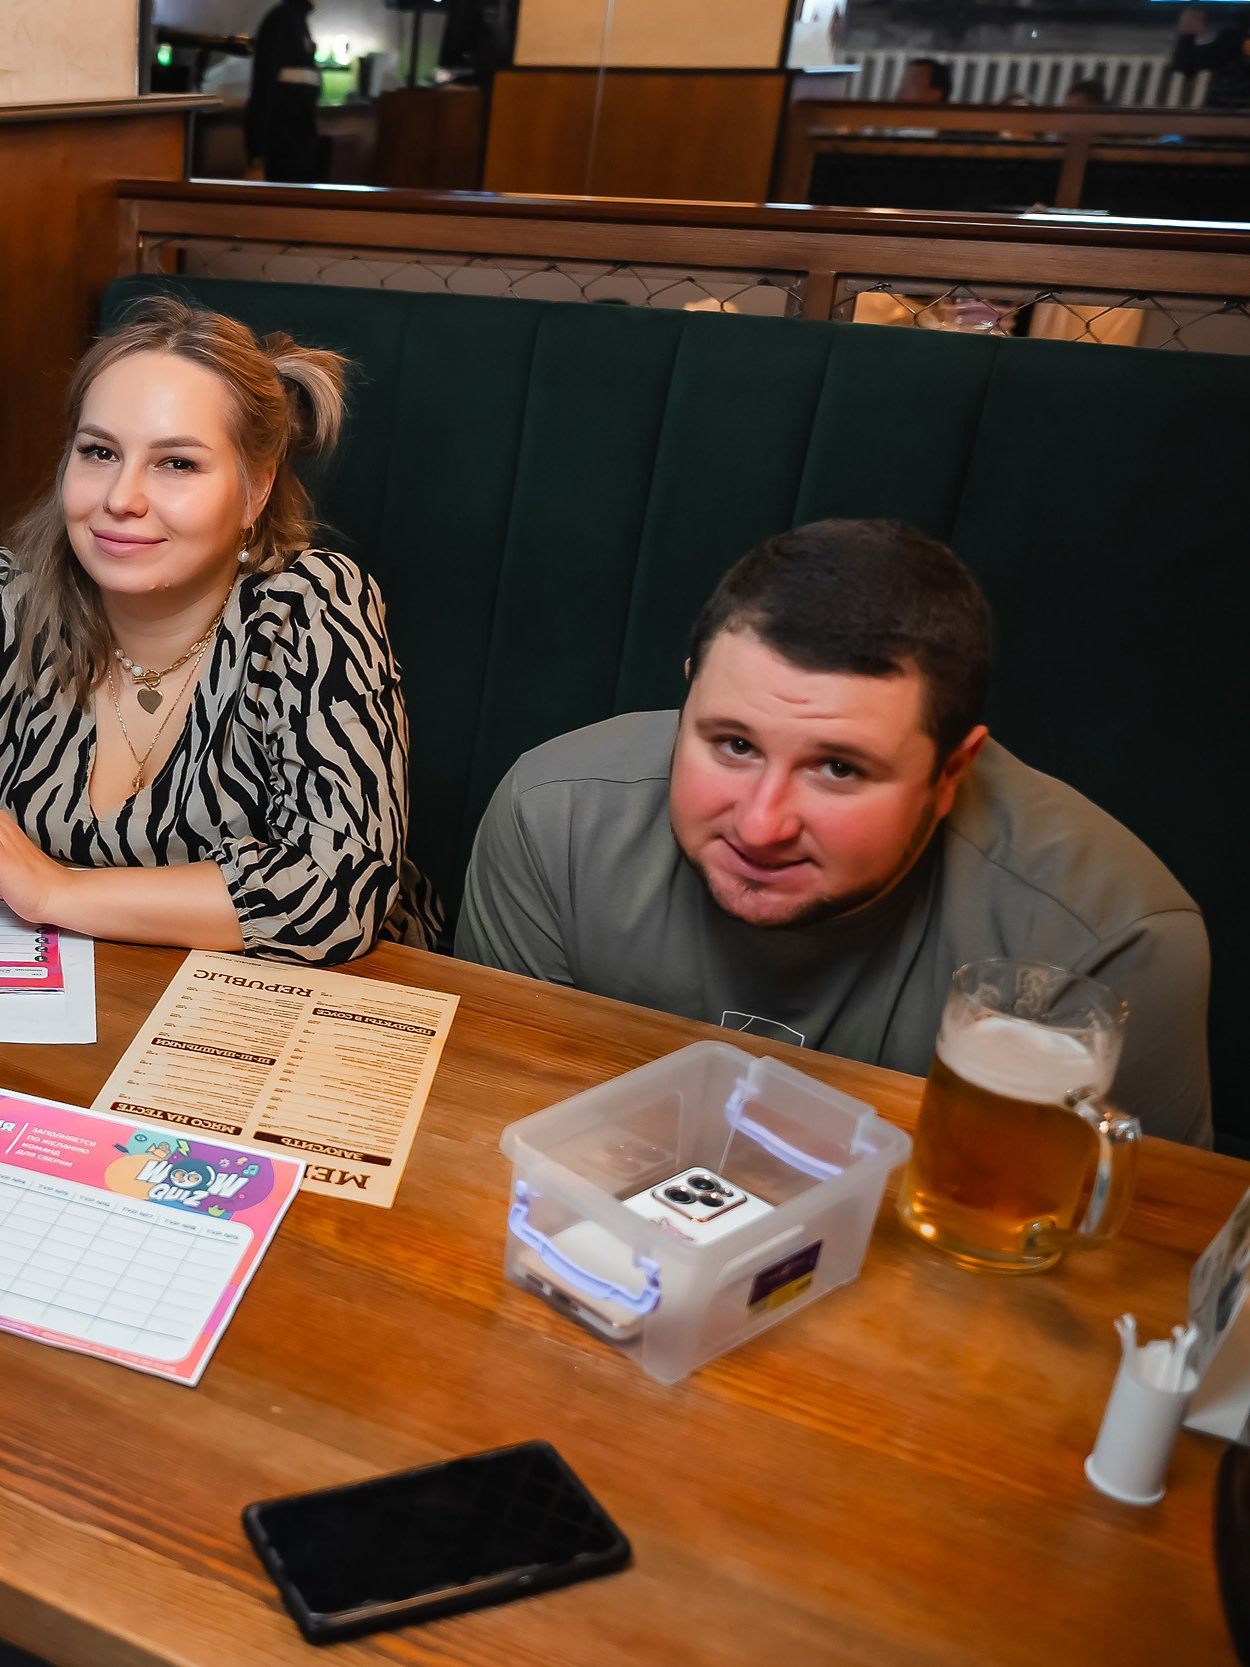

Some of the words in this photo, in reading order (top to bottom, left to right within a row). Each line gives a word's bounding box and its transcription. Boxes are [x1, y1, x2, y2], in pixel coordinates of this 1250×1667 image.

[192, 969, 314, 998] REPUBLIC
[316, 1009, 354, 1020] СОУСЕ
[364, 1017, 433, 1035] ПРОДУКТЫ
[117, 1103, 164, 1118] ТЕСТЕ
[166, 1111, 189, 1124] НА
[190, 1117, 236, 1134] МЯСО
[26, 1134, 41, 1142] ПО
[42, 1138, 90, 1154] ЖЕЛАНИЮ
[32, 1126, 97, 1147] ЗАПОЛНЯЕТСЯ
[15, 1149, 37, 1158] ДЛЯ
[21, 1142, 61, 1156] КОМАНД
[280, 1137, 365, 1160] ЗАКУСИТЬ
[148, 1182, 211, 1207] QUIZ
